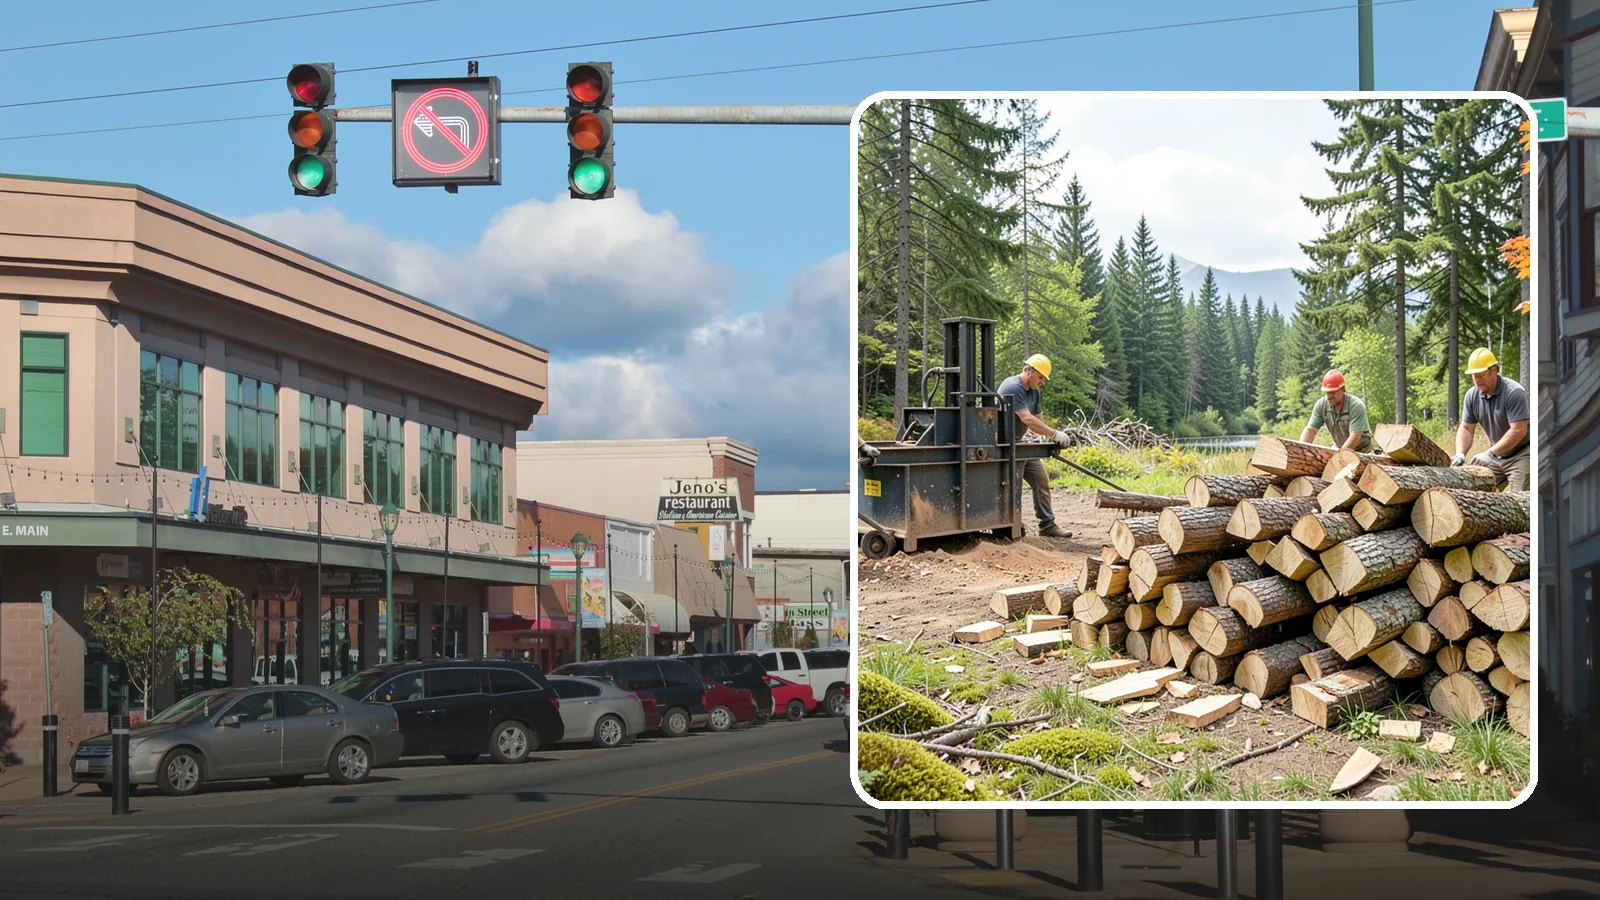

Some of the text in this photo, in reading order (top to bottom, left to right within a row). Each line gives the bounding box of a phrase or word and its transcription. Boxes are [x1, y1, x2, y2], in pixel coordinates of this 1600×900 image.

[670, 480, 727, 494] Jeno's
[665, 497, 731, 508] restaurant
[659, 510, 681, 519] Italian
[686, 510, 714, 519] American
[715, 510, 737, 519] Cuisine
[2, 525, 49, 536] E. MAIN
[798, 608, 828, 616] Street
